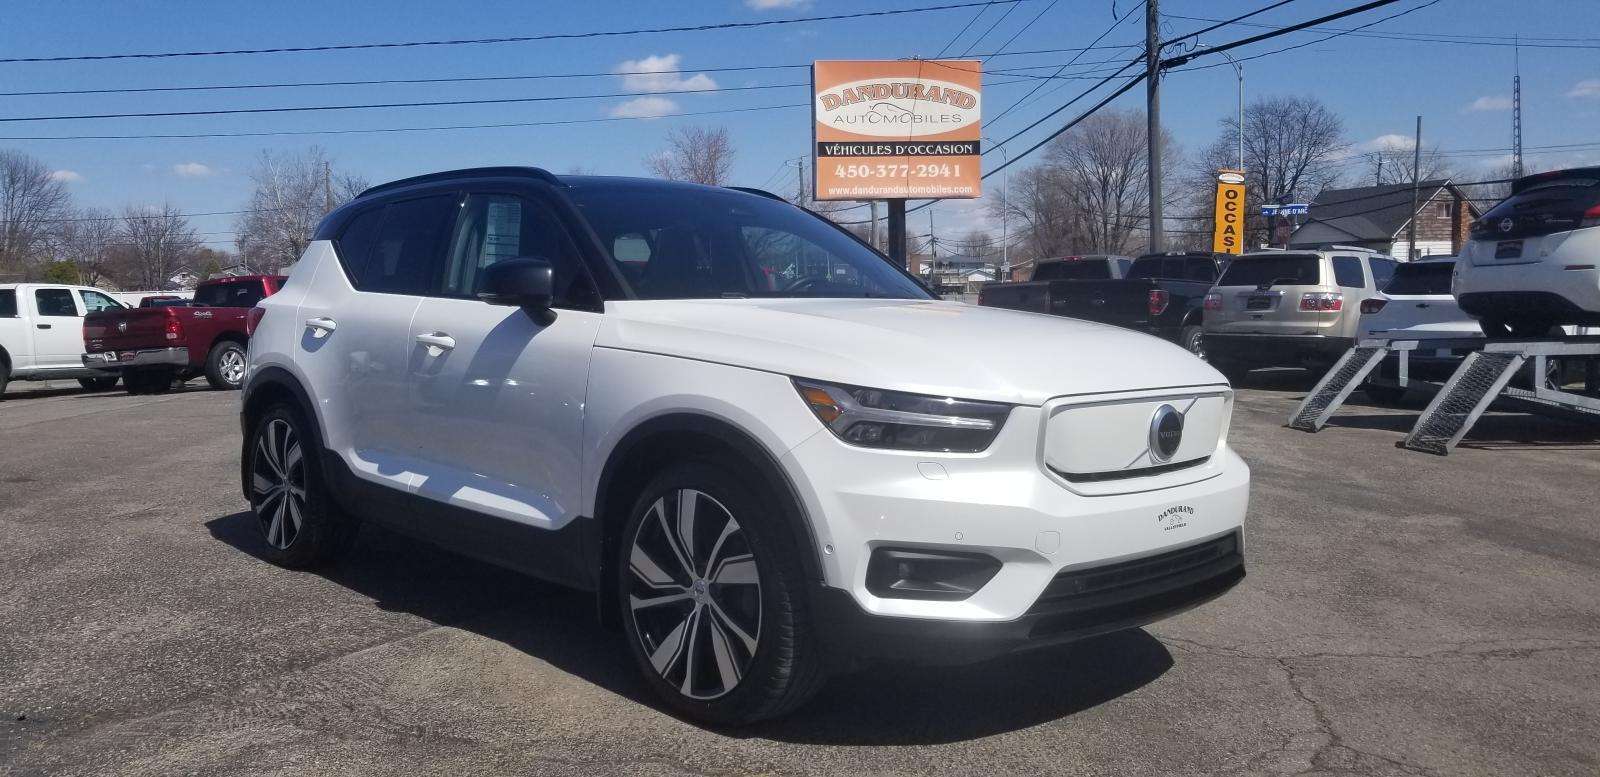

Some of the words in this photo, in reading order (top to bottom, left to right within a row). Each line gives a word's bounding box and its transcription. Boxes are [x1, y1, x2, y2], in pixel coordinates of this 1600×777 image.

[820, 83, 977, 111] DANDURAND
[833, 113, 962, 124] AUTOMOBILES
[825, 143, 892, 155] VÉHICULES
[896, 144, 973, 155] D'OCCASION
[834, 164, 961, 178] 450-377-2941
[828, 183, 973, 195] www.dandurandautomobiles.com
[1157, 505, 1194, 522] DANDURAND
